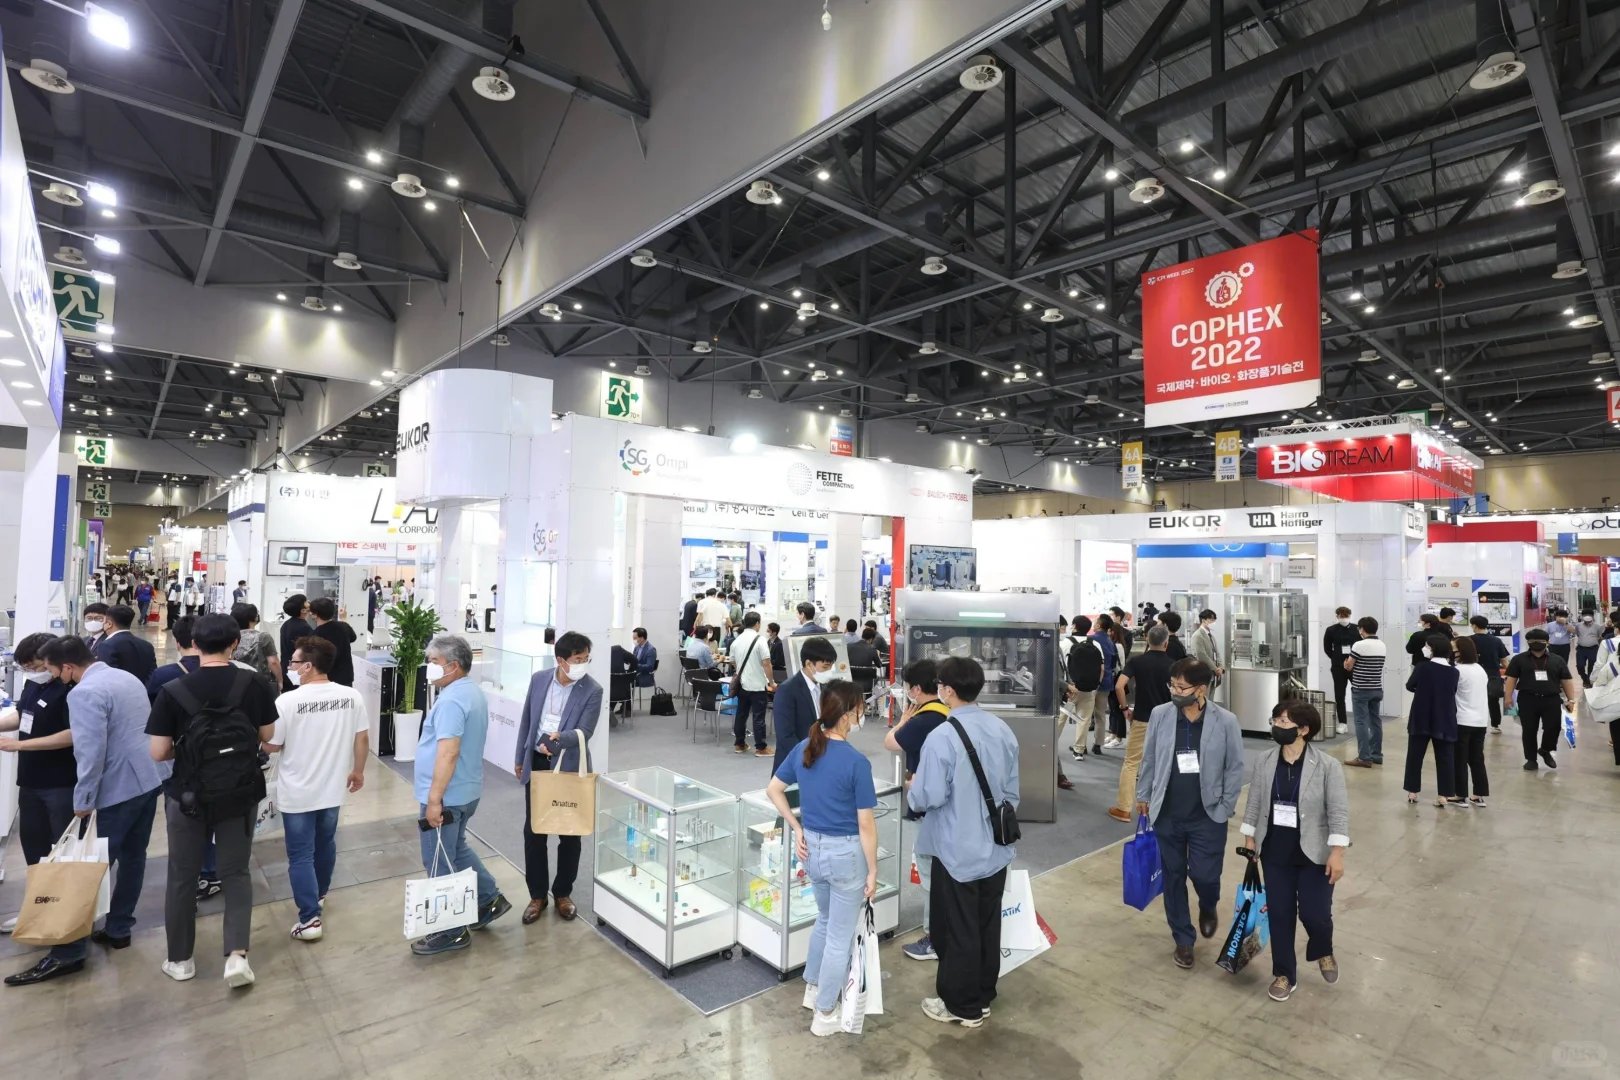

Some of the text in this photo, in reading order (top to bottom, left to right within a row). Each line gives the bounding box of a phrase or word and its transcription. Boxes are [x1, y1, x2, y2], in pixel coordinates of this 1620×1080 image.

[1171, 303, 1284, 348] COPHEX
[1191, 336, 1262, 371] 2022
[396, 422, 430, 452] EUKOR
[1217, 437, 1238, 452] 4B
[627, 447, 689, 470] SG Ompi
[1124, 447, 1141, 462] 4A
[816, 470, 843, 482] FETTE
[279, 485, 300, 498] (주)
[822, 480, 855, 490] COMPACTING
[1149, 515, 1222, 529] EUKOR
[1280, 511, 1309, 519] Harro
[1280, 517, 1323, 529] Höfliger
[536, 529, 546, 545] SG
